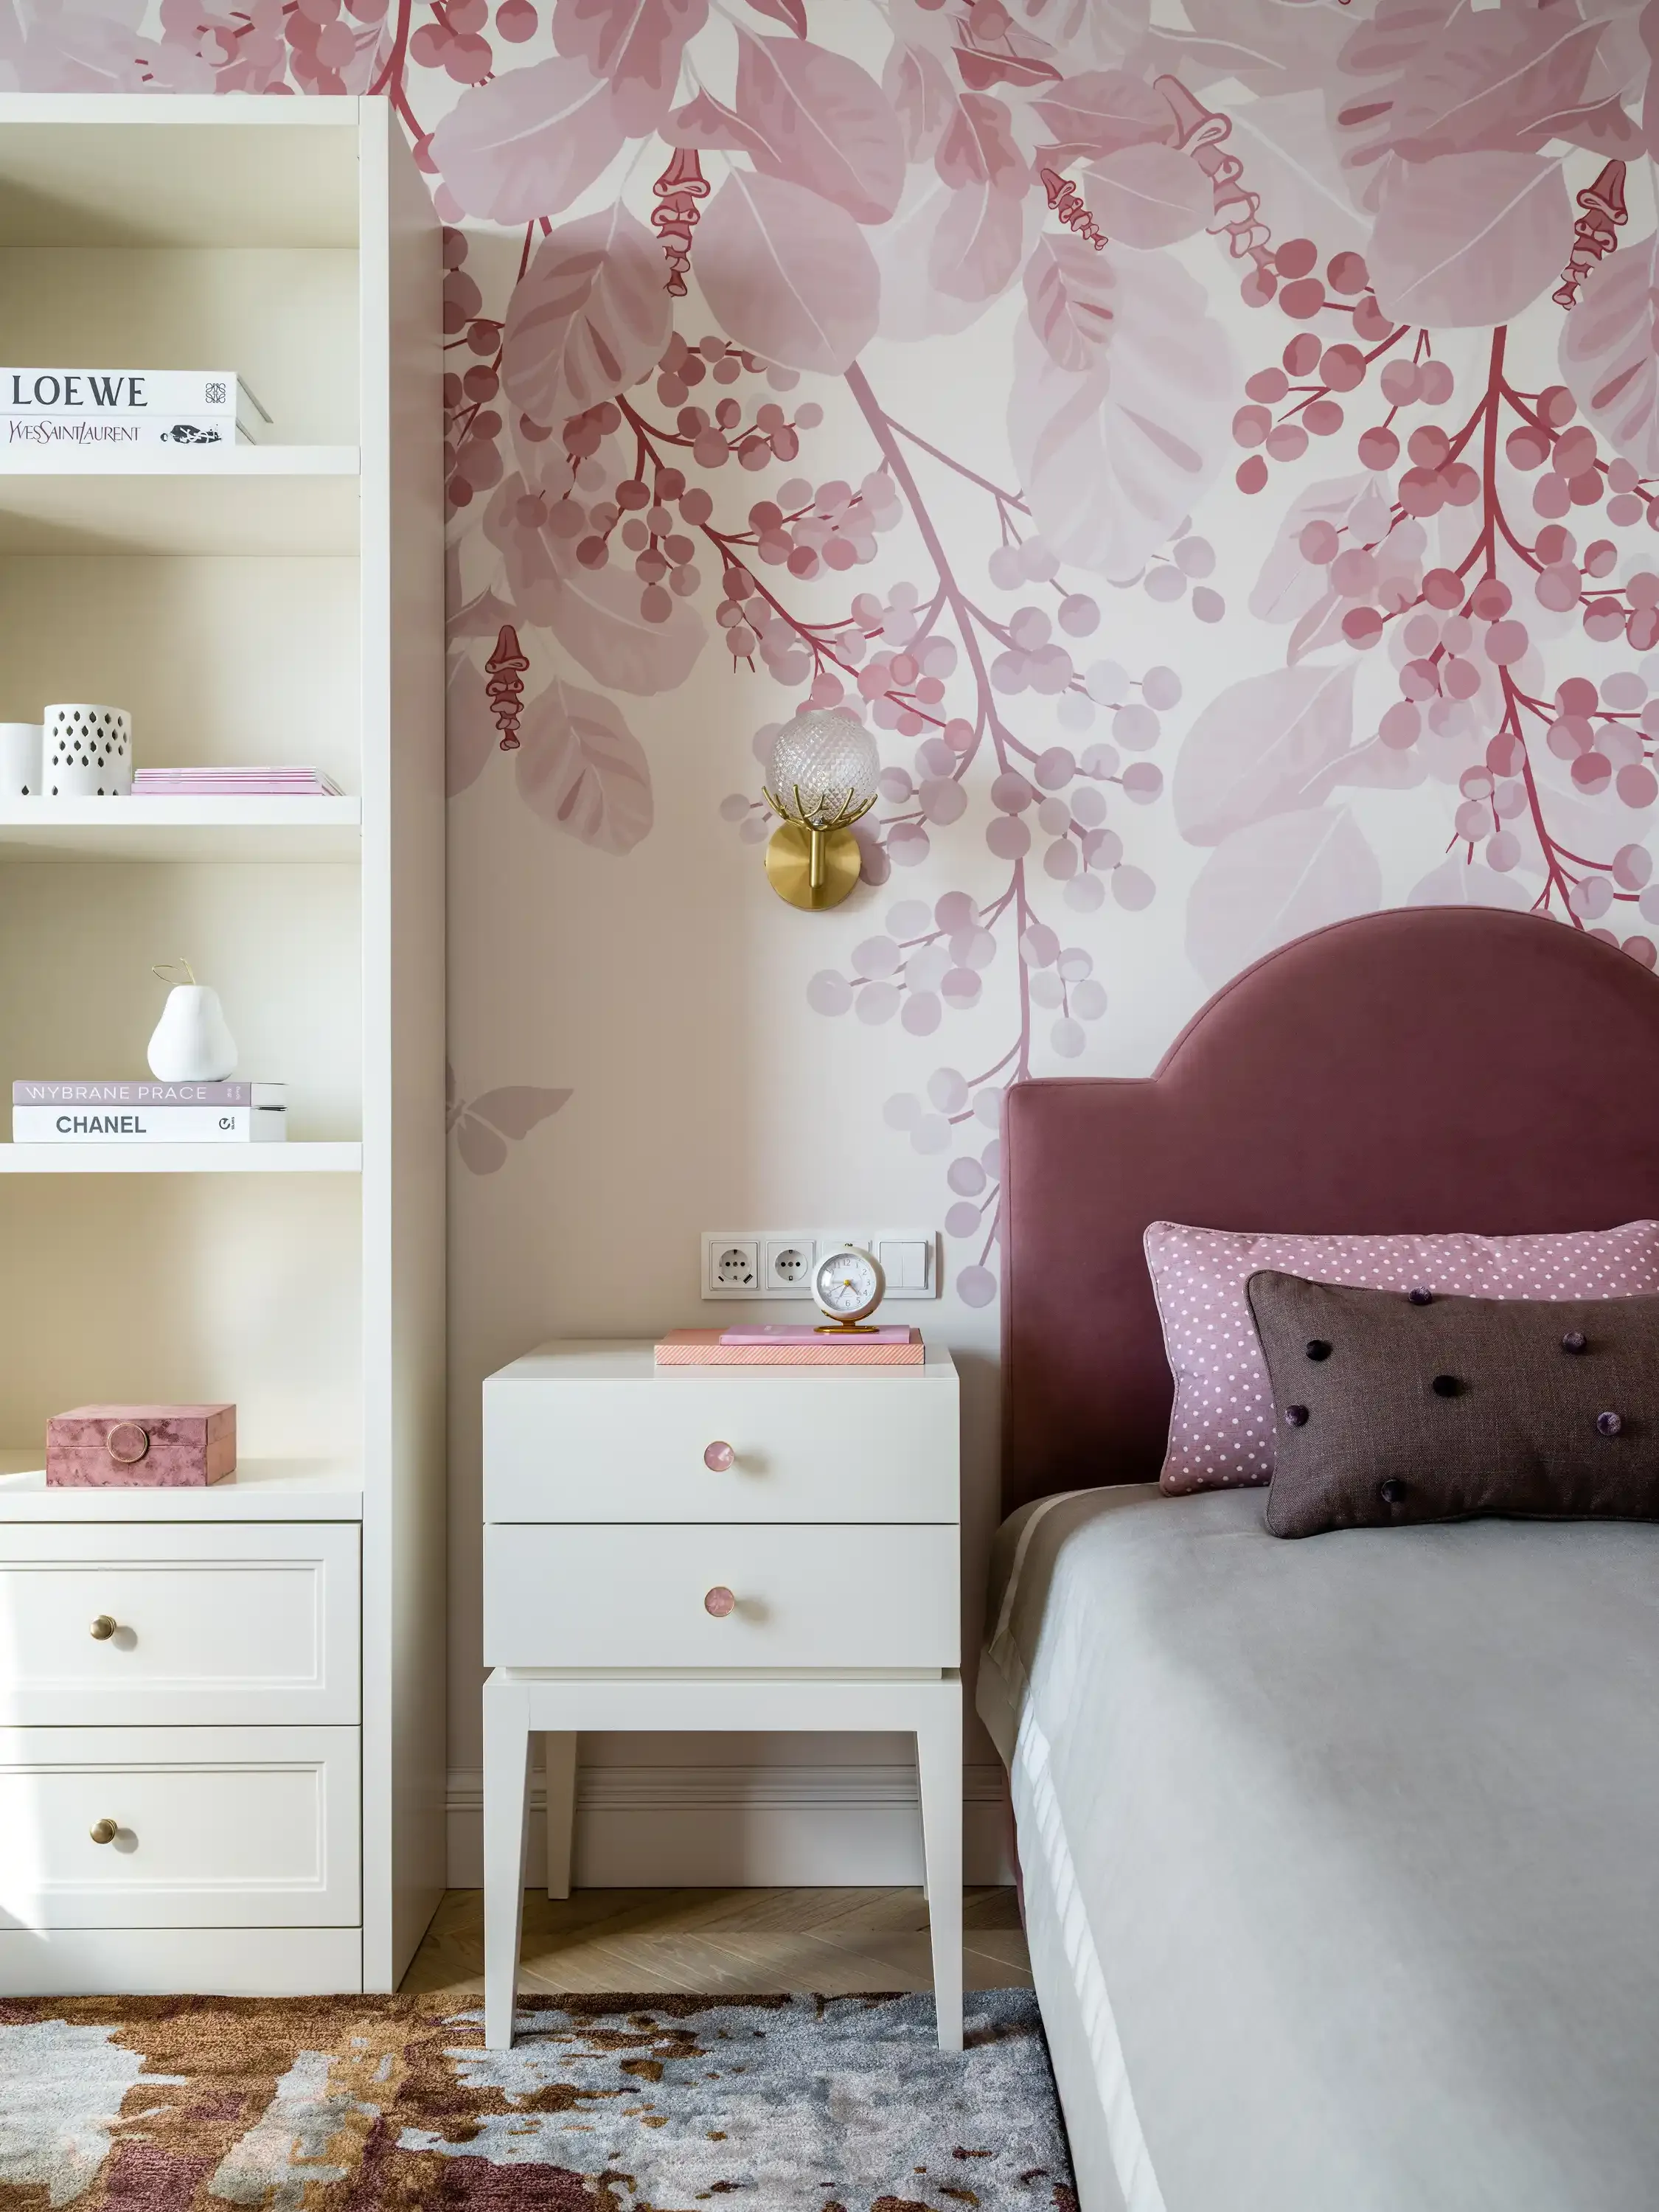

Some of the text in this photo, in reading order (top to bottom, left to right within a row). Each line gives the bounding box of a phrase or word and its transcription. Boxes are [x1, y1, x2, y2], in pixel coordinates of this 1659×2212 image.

[12, 375, 147, 406] LOEWE
[25, 1086, 206, 1099] WYBRANE PRACE
[56, 1116, 147, 1133] CHANEL
[855, 1296, 860, 1304] 5
